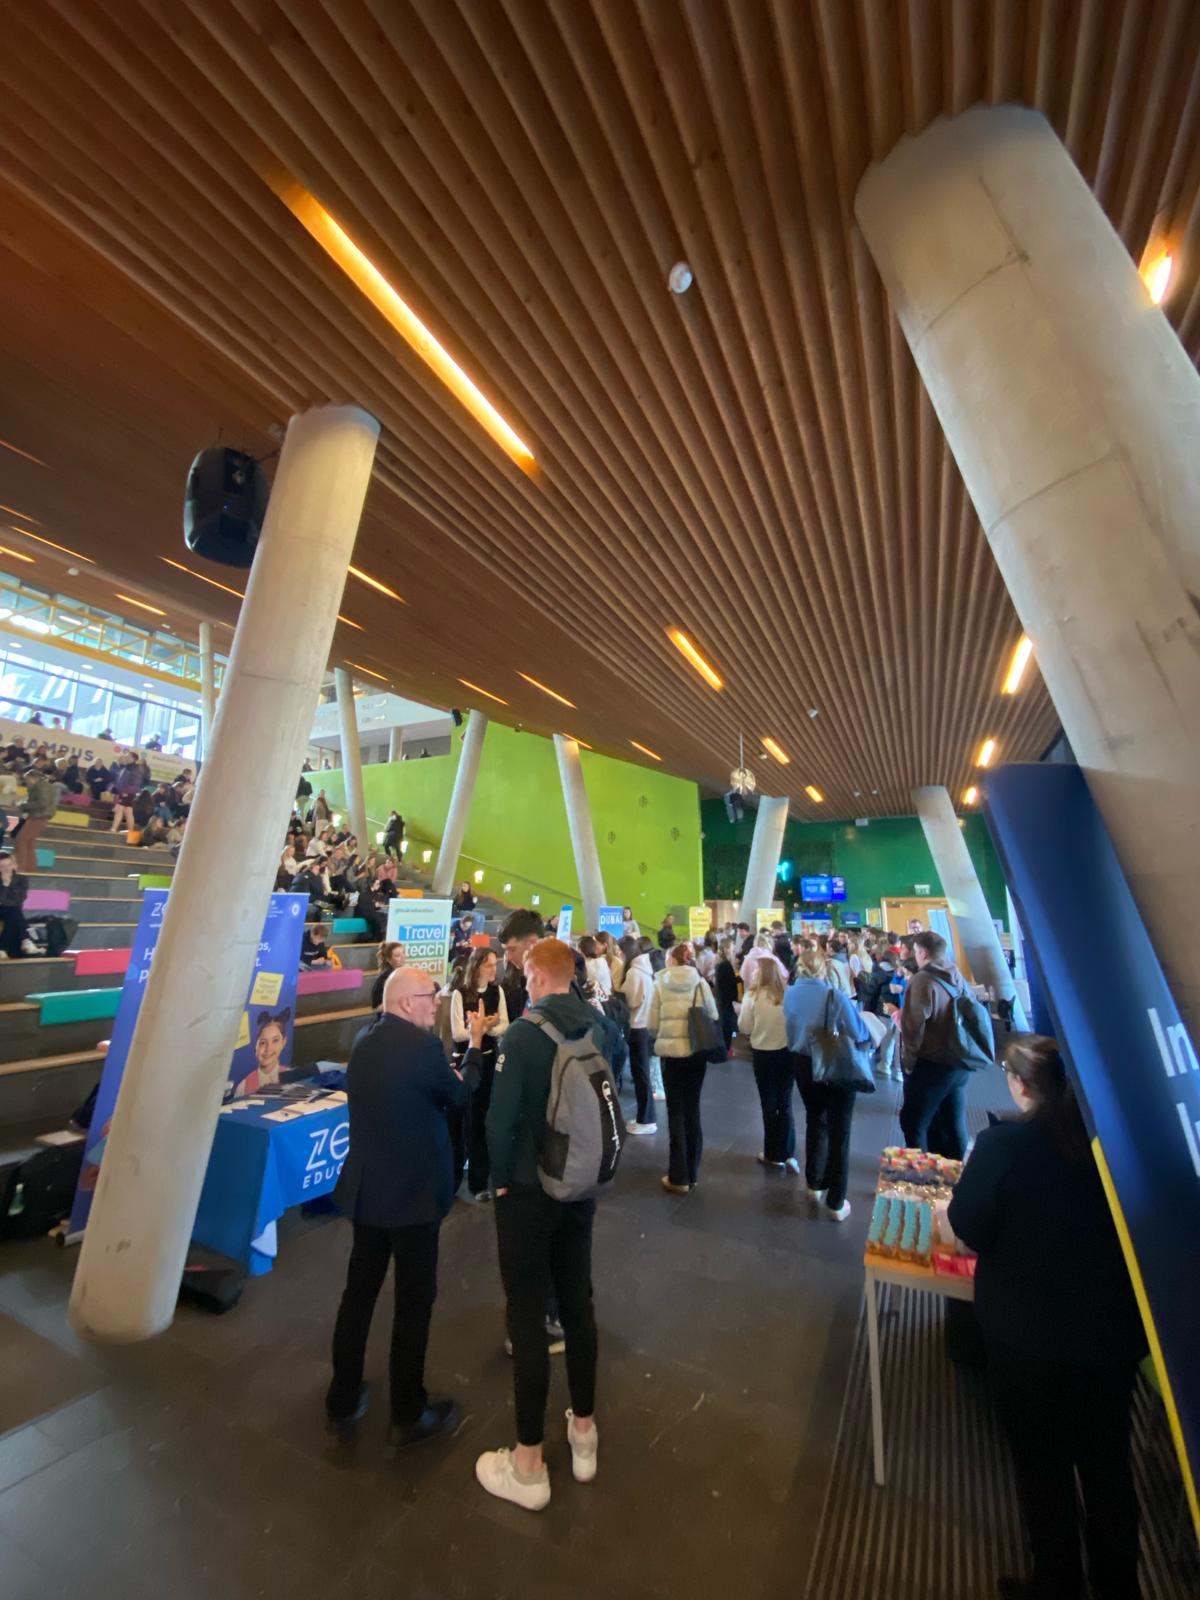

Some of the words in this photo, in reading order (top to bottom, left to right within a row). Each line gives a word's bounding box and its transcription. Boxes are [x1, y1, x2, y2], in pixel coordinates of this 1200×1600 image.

[26, 737, 95, 762] AMPUS
[404, 924, 444, 940] Travel
[404, 942, 444, 957] teach
[1176, 1101, 1200, 1178] I
